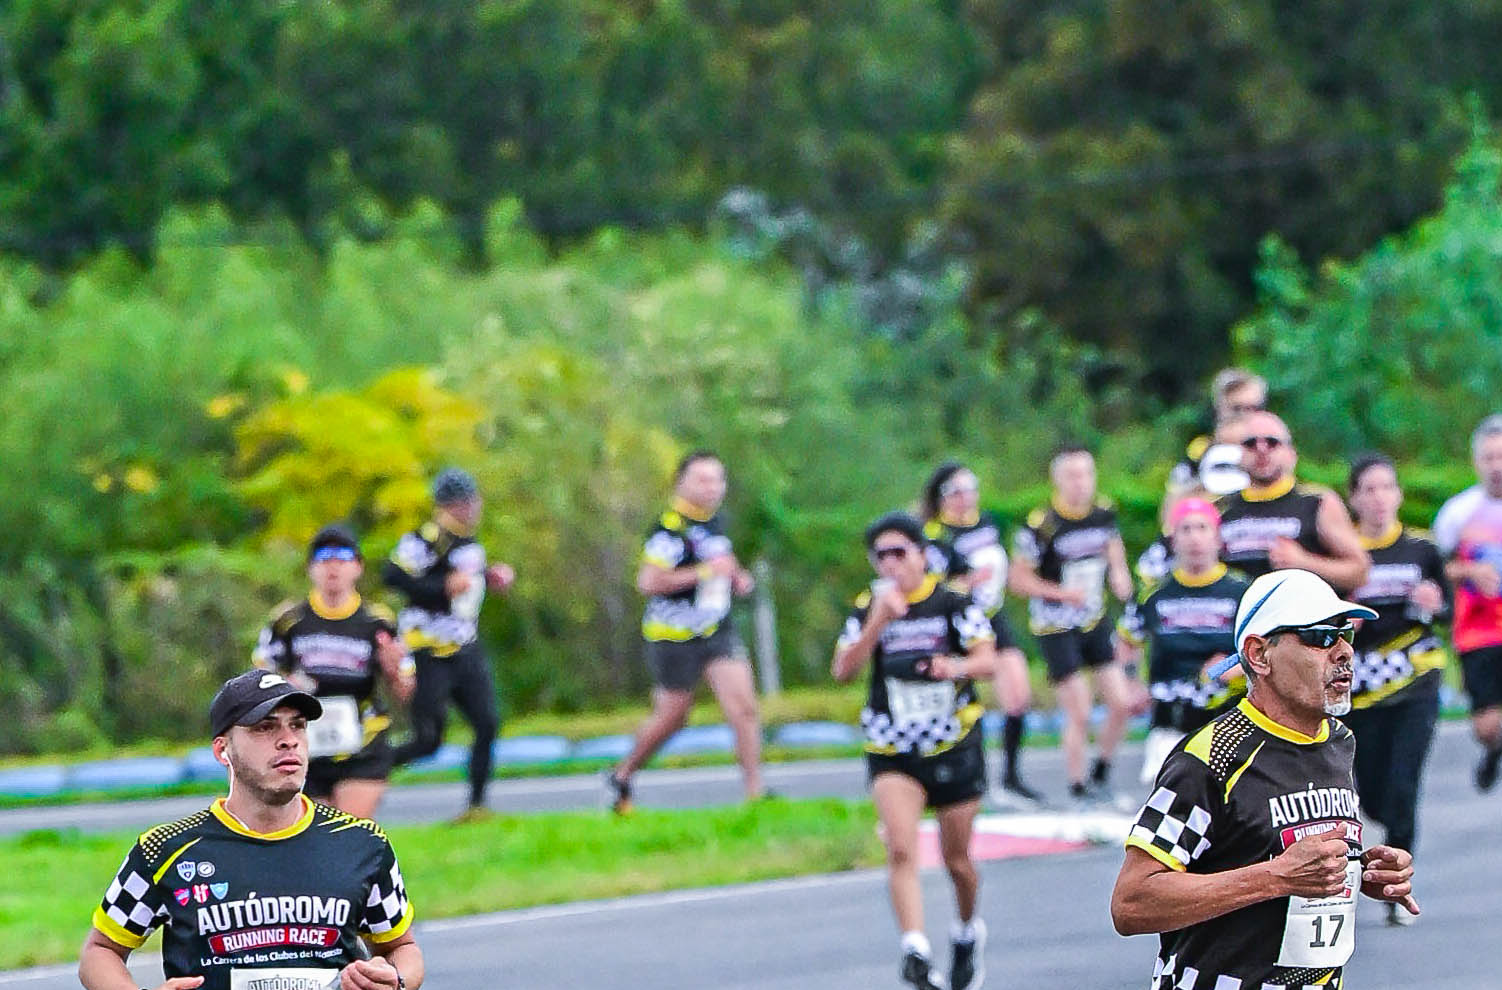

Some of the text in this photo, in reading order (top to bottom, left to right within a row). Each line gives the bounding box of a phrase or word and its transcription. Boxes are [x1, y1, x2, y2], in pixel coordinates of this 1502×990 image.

[1268, 782, 1361, 828] AUTÓDROM
[197, 892, 351, 936] AUTÓDROMO
[1310, 914, 1345, 947] 17
[222, 928, 327, 952] RUNNING RACE
[200, 957, 211, 967] La
[212, 955, 242, 965] Carrera
[255, 953, 268, 963] los
[269, 950, 298, 961] Clubes
[299, 950, 313, 959] del
